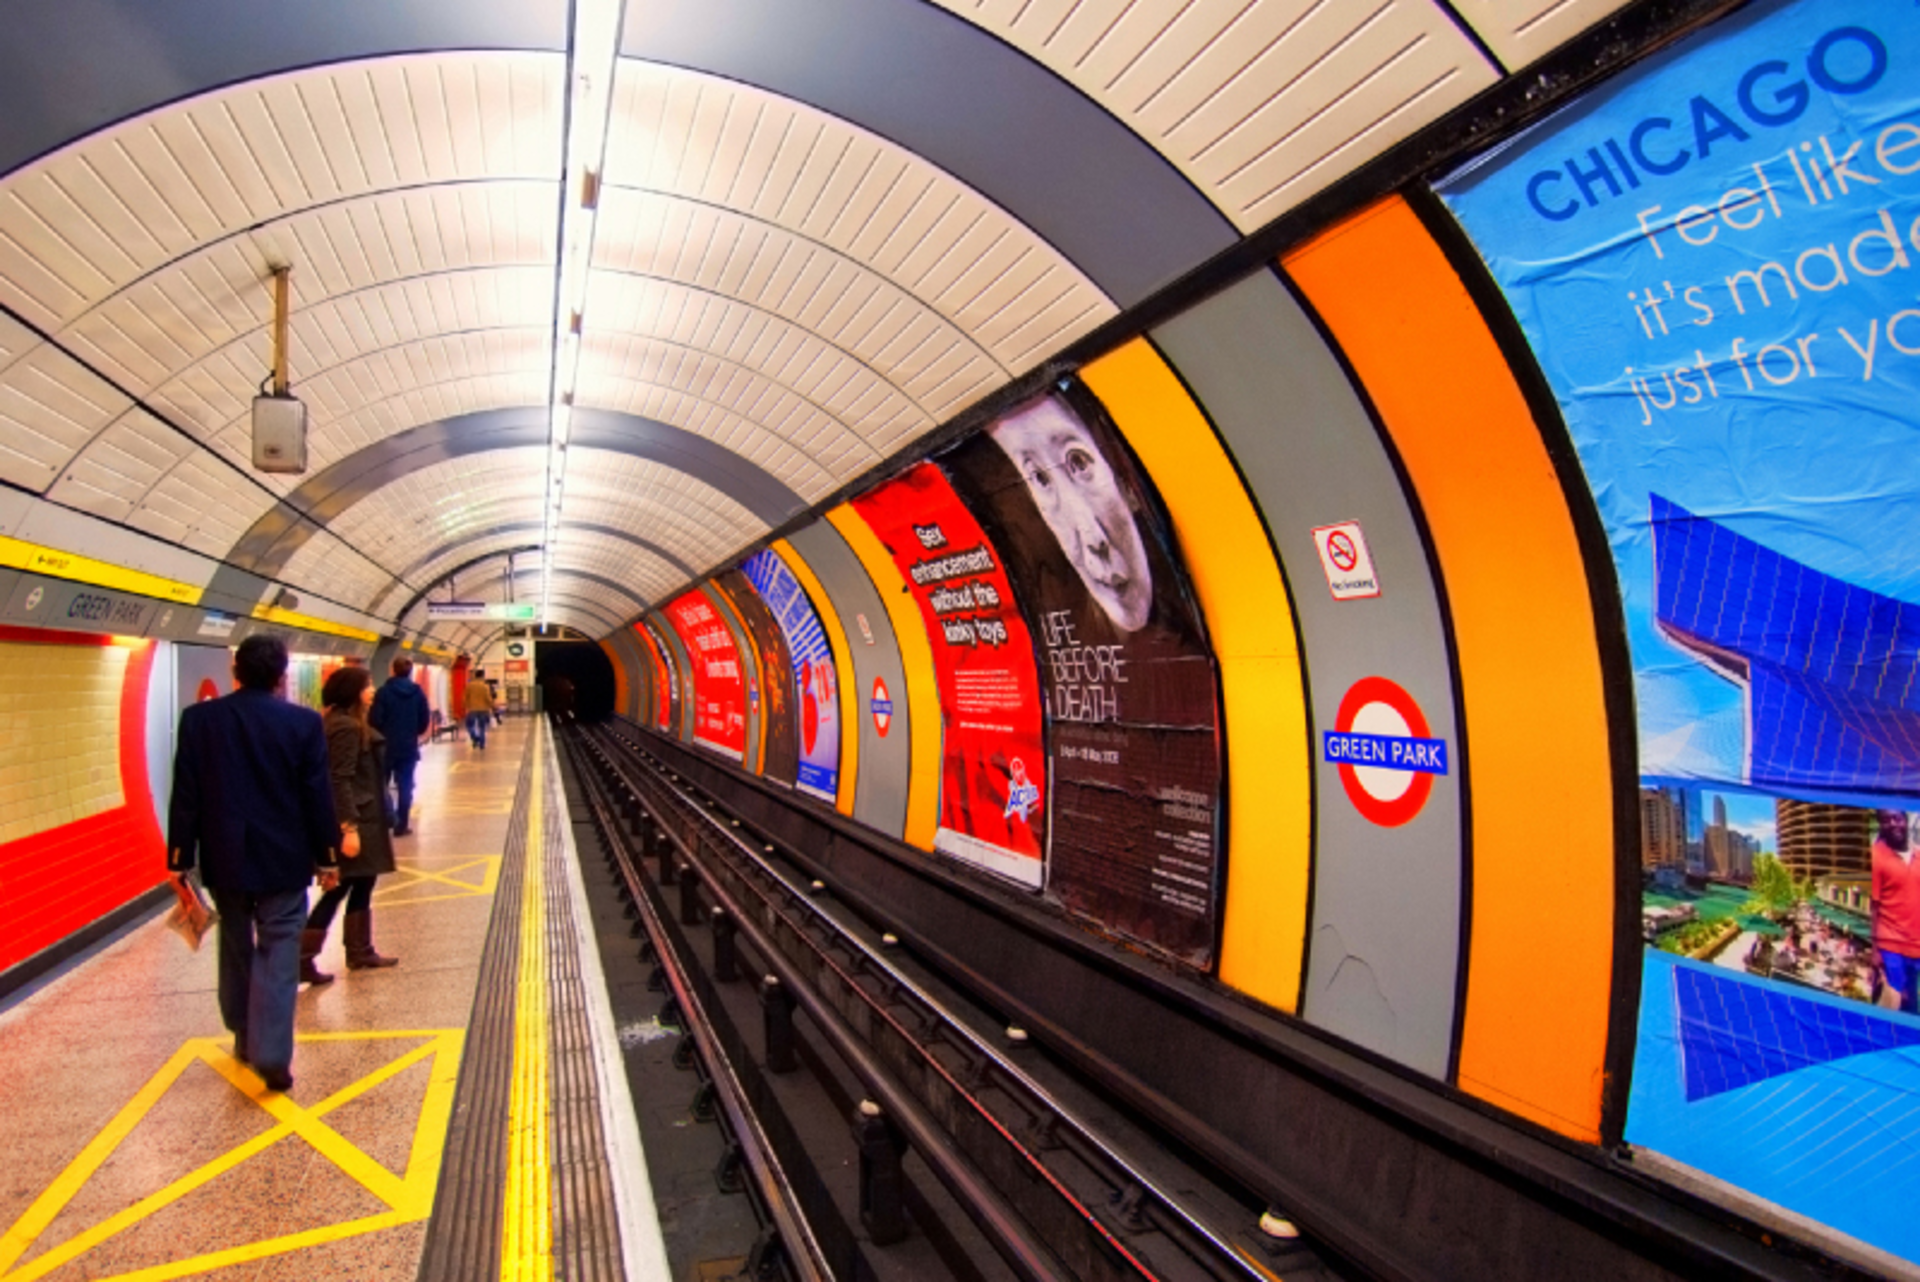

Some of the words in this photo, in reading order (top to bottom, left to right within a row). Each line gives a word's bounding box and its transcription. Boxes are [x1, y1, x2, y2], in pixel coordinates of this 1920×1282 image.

[1527, 26, 1888, 221] CHICAGO
[1636, 163, 1782, 259] Feel
[1787, 123, 1920, 206] like
[1627, 280, 1714, 339] it's
[1725, 209, 1920, 315] mad
[1625, 349, 1719, 425] just
[1730, 337, 1819, 390] for
[910, 544, 995, 585] enhancement
[67, 592, 111, 620] GREEN
[110, 599, 147, 625] PARK
[931, 585, 976, 612] without
[972, 581, 1000, 607] the
[942, 618, 977, 646] kinky
[974, 617, 1008, 647] toys
[1040, 609, 1081, 647] LIFE
[1048, 646, 1129, 683] BEFORE
[1056, 685, 1118, 723] DEATH
[1327, 736, 1386, 762] GREEN
[1391, 741, 1443, 769] PARK
